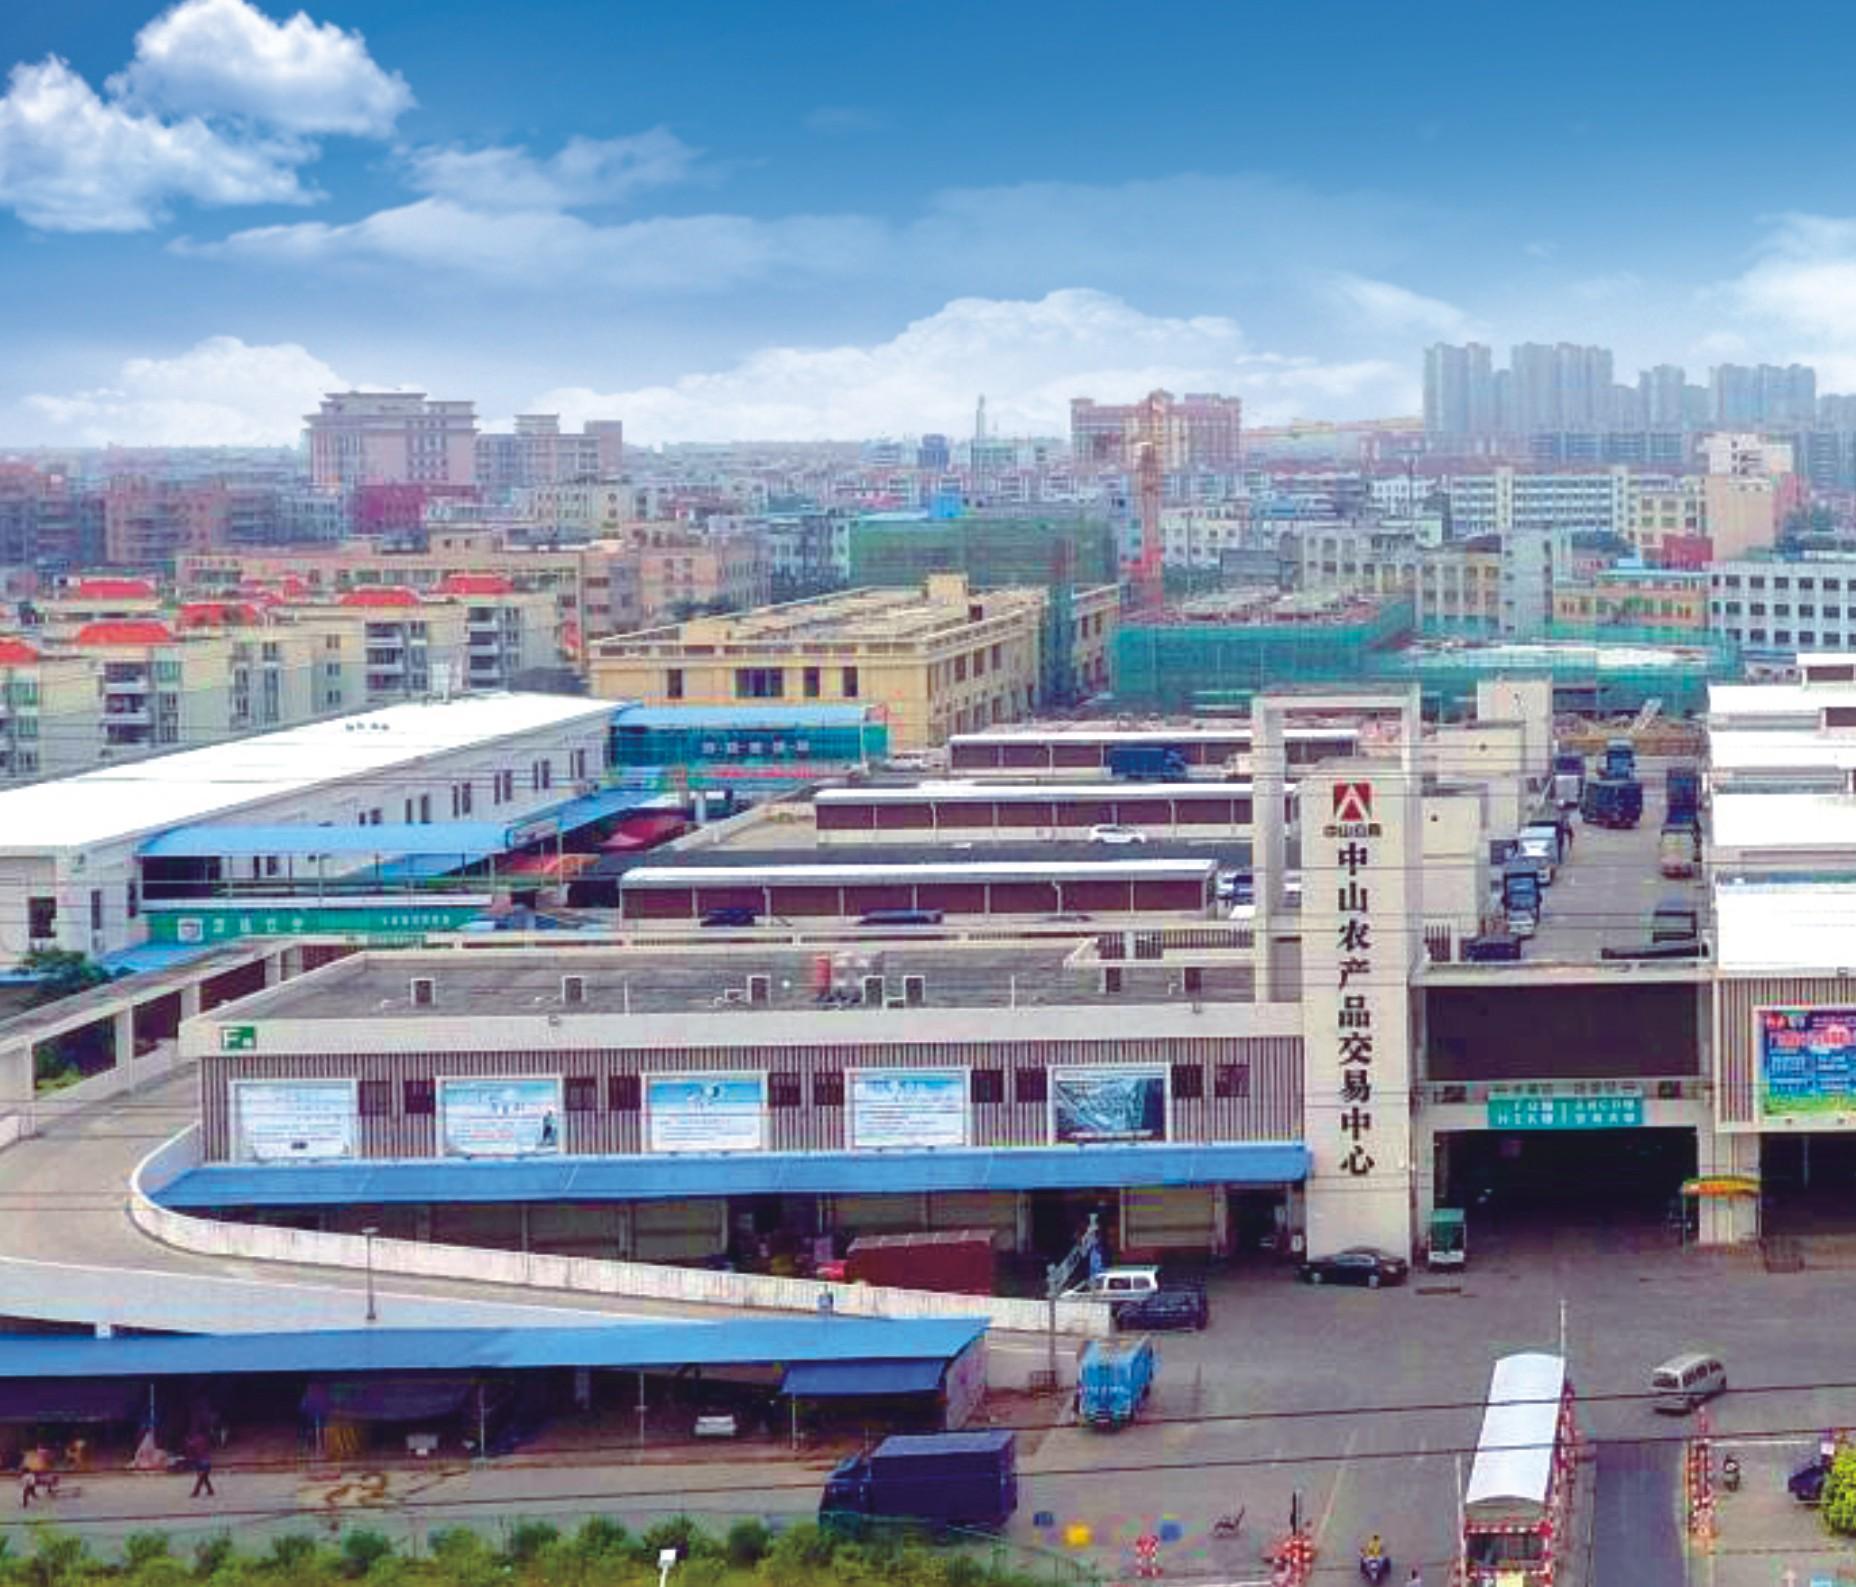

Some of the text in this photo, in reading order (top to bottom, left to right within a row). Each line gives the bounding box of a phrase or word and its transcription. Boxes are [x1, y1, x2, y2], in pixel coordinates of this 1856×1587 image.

[1336, 841, 1374, 1176] 中山农产品交易中心
